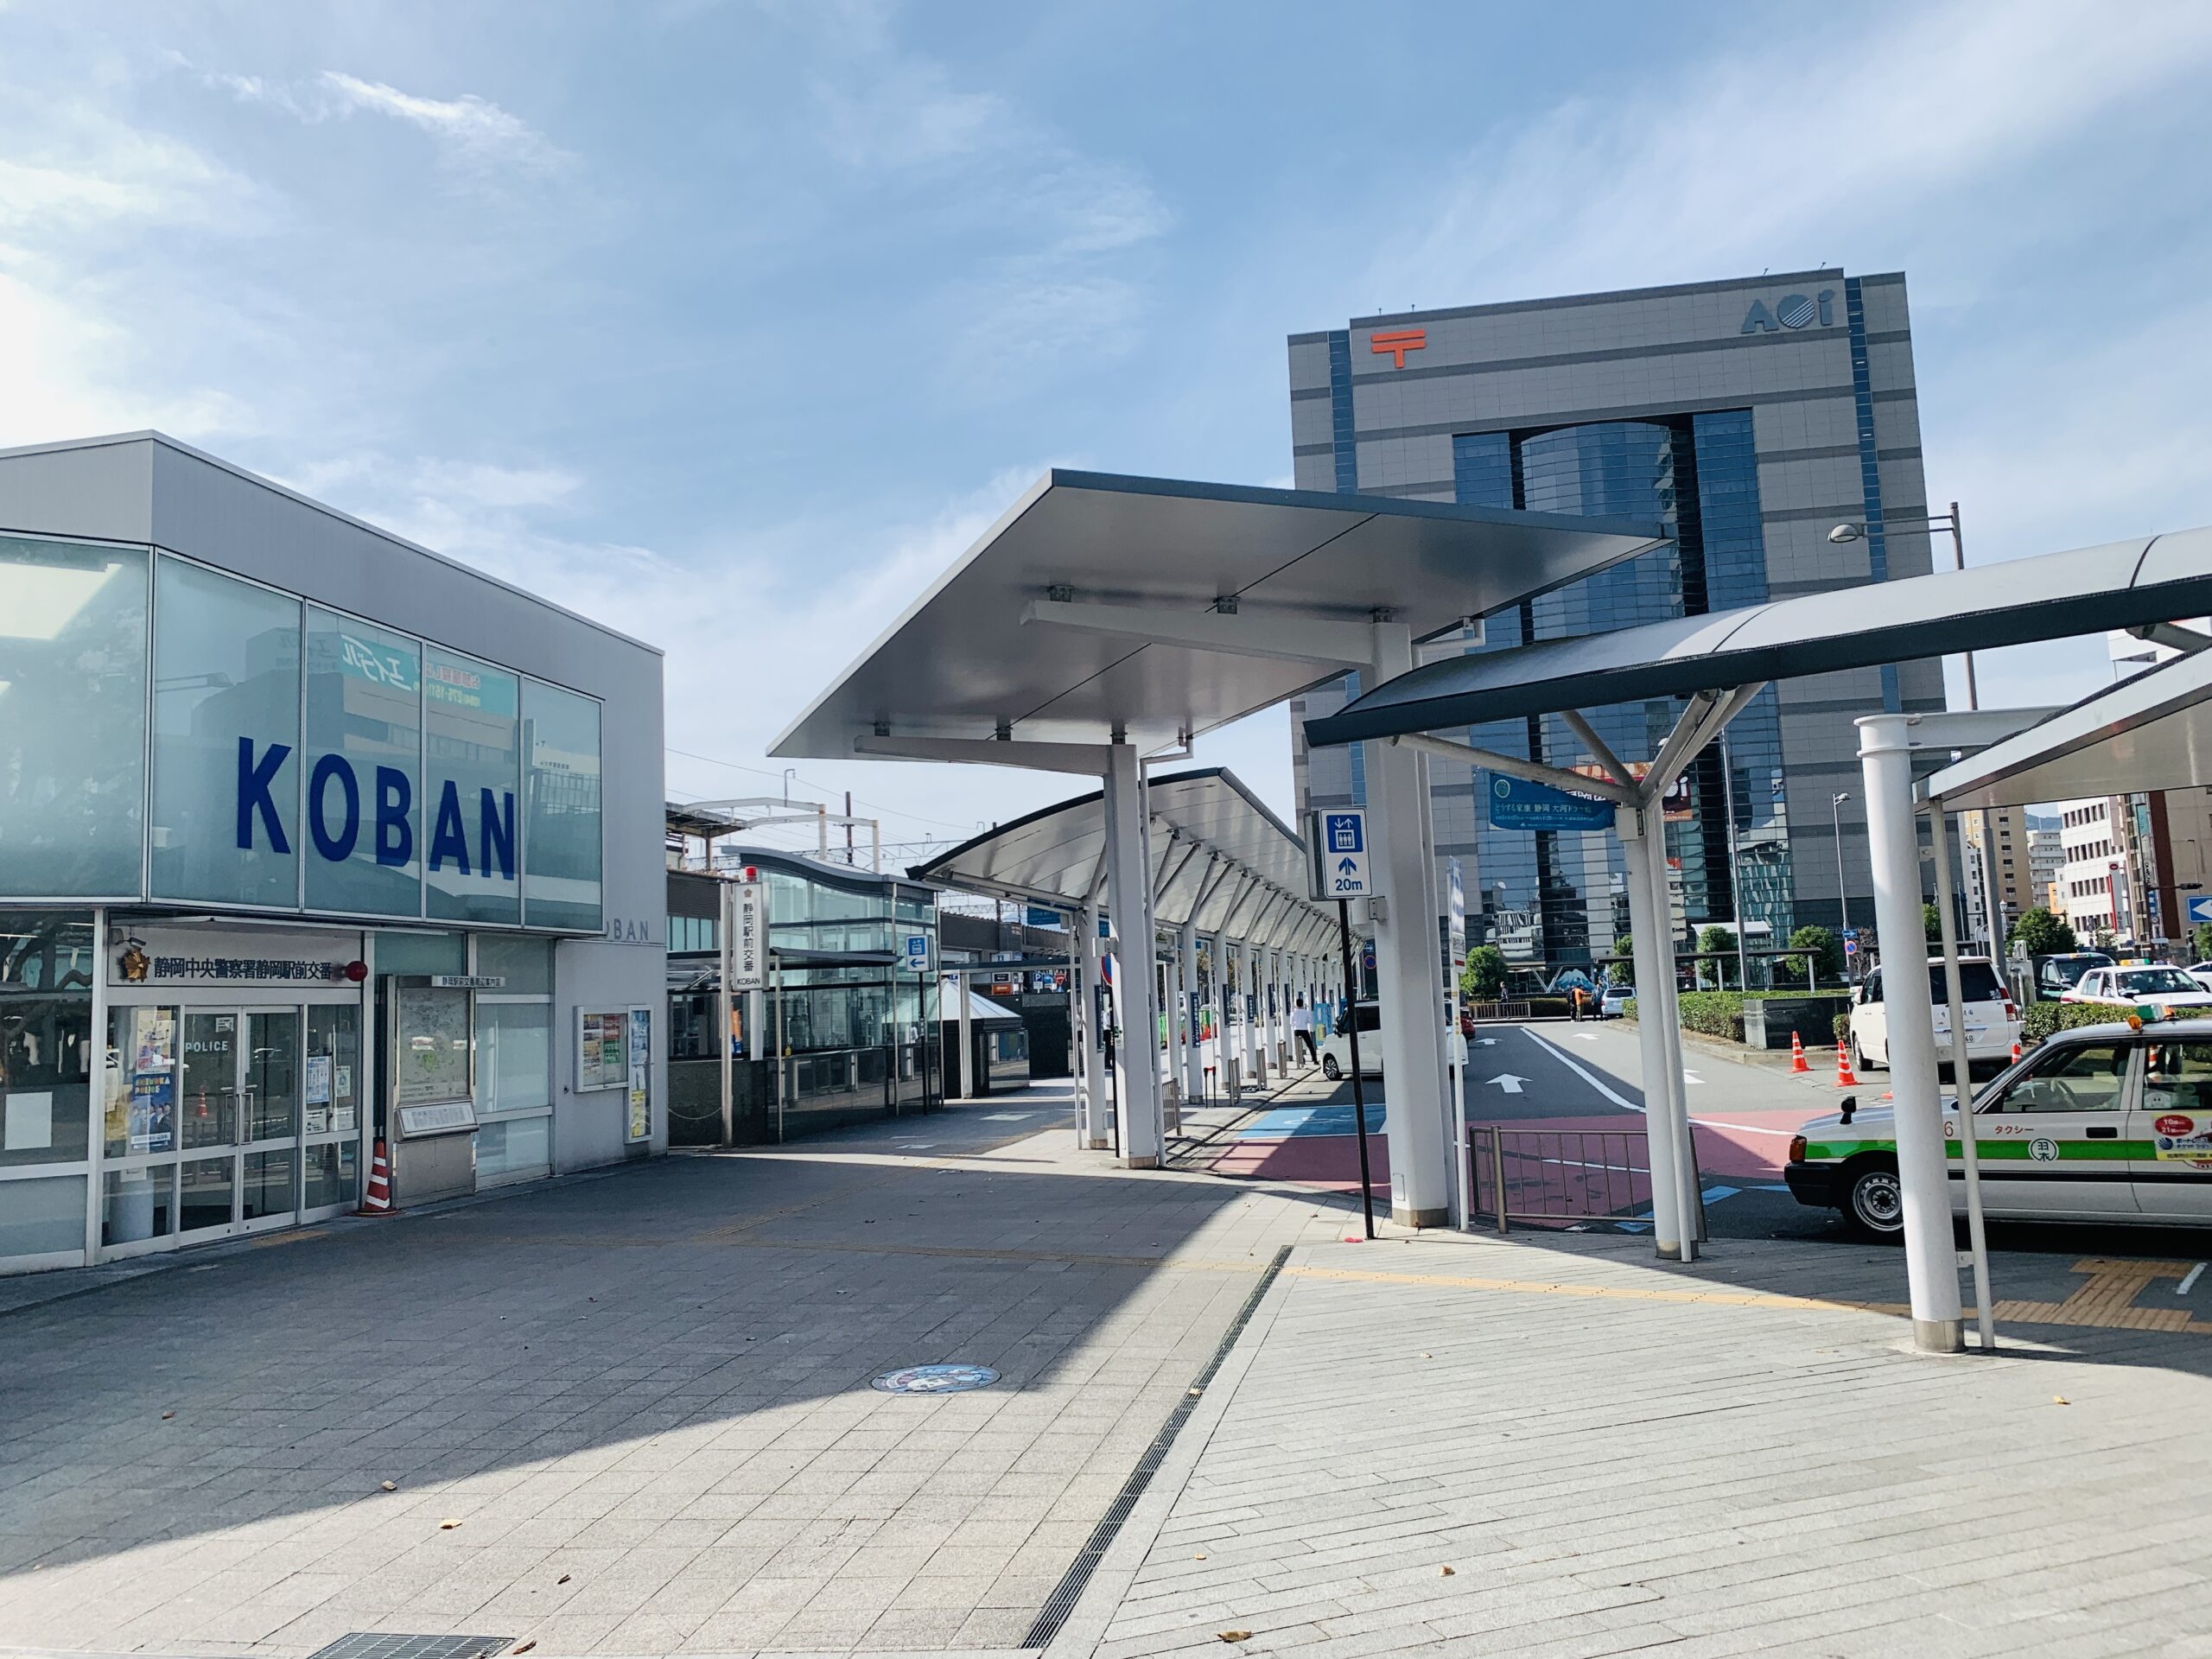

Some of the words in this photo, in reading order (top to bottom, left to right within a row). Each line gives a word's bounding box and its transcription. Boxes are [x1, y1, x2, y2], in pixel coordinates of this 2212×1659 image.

[236, 736, 516, 881] KOBAN
[1335, 878, 1363, 891] 20m
[743, 903, 754, 972] 静岡駅前交番
[154, 957, 333, 981] 静岡中央警察署静岡駅前交番
[737, 977, 760, 986] KOBAN
[185, 1040, 229, 1052] POLICE
[1994, 1125, 2035, 1135] タクシー
